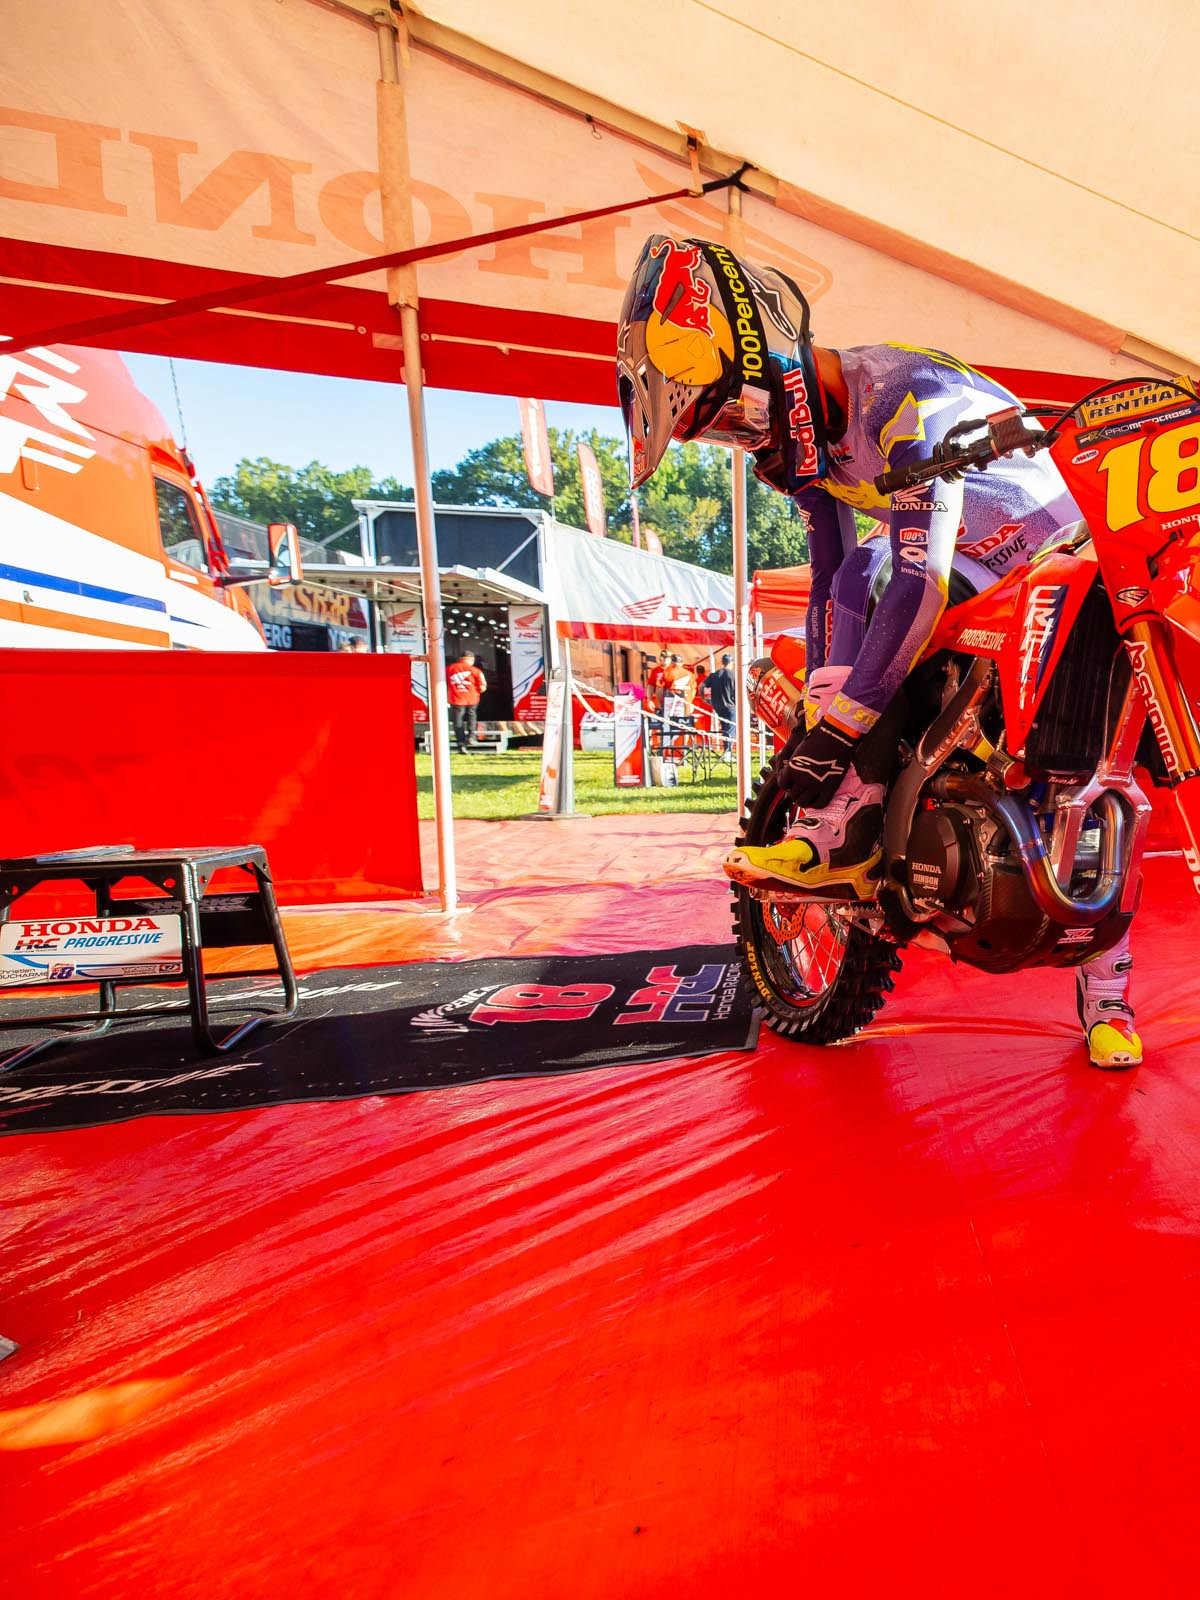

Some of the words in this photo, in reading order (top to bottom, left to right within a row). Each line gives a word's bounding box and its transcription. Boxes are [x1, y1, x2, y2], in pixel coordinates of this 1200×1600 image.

[708, 246, 763, 381] 100Percent
[891, 501, 948, 512] HONDA
[902, 531, 925, 542] 100%
[957, 628, 1007, 651] PROGRESSIVE
[911, 861, 942, 874] HONDA
[21, 917, 160, 938] HONDA
[15, 938, 60, 950] HRC
[63, 933, 164, 949] PROGRESSIVE
[746, 941, 772, 999] DUNLOP
[468, 983, 616, 1027] 18
[613, 964, 726, 1025] HRC
